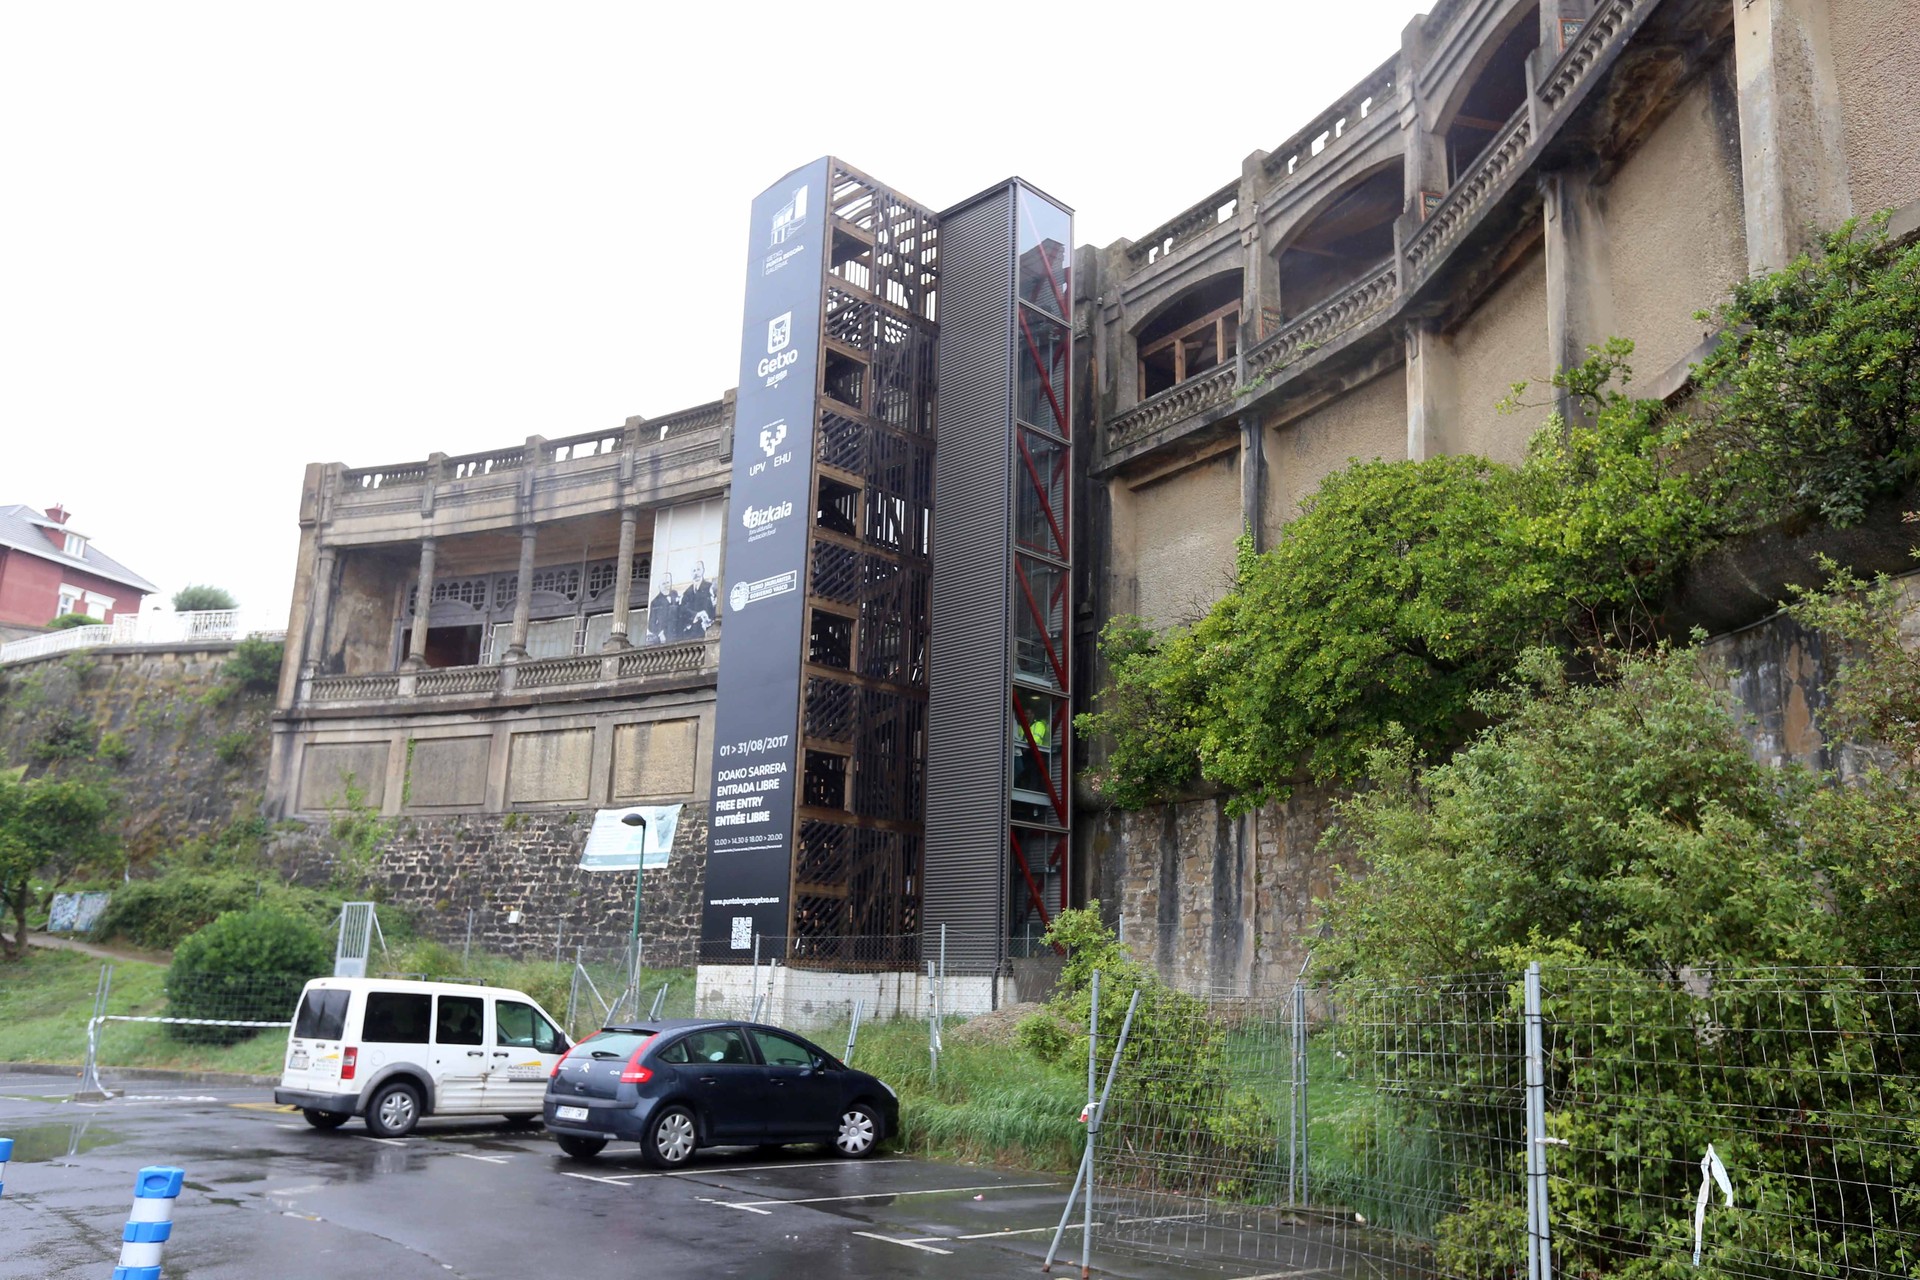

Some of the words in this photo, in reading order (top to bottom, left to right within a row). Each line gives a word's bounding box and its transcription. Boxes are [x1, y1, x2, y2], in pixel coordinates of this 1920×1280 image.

[758, 350, 798, 377] Getxo
[750, 462, 766, 476] UPV
[774, 452, 792, 467] EHU
[750, 501, 792, 528] Bizkaia
[720, 745, 730, 756] 01
[738, 734, 788, 756] 31/08/2017
[718, 768, 747, 782] DOAKO
[748, 762, 787, 778] SARRERA
[717, 782, 755, 796] ENTRADA
[756, 778, 780, 792] LIBRE
[716, 799, 736, 812] FREE
[736, 796, 764, 809] ENTRY
[715, 812, 746, 826] ENTRÉE
[746, 810, 770, 823] LIBRE
